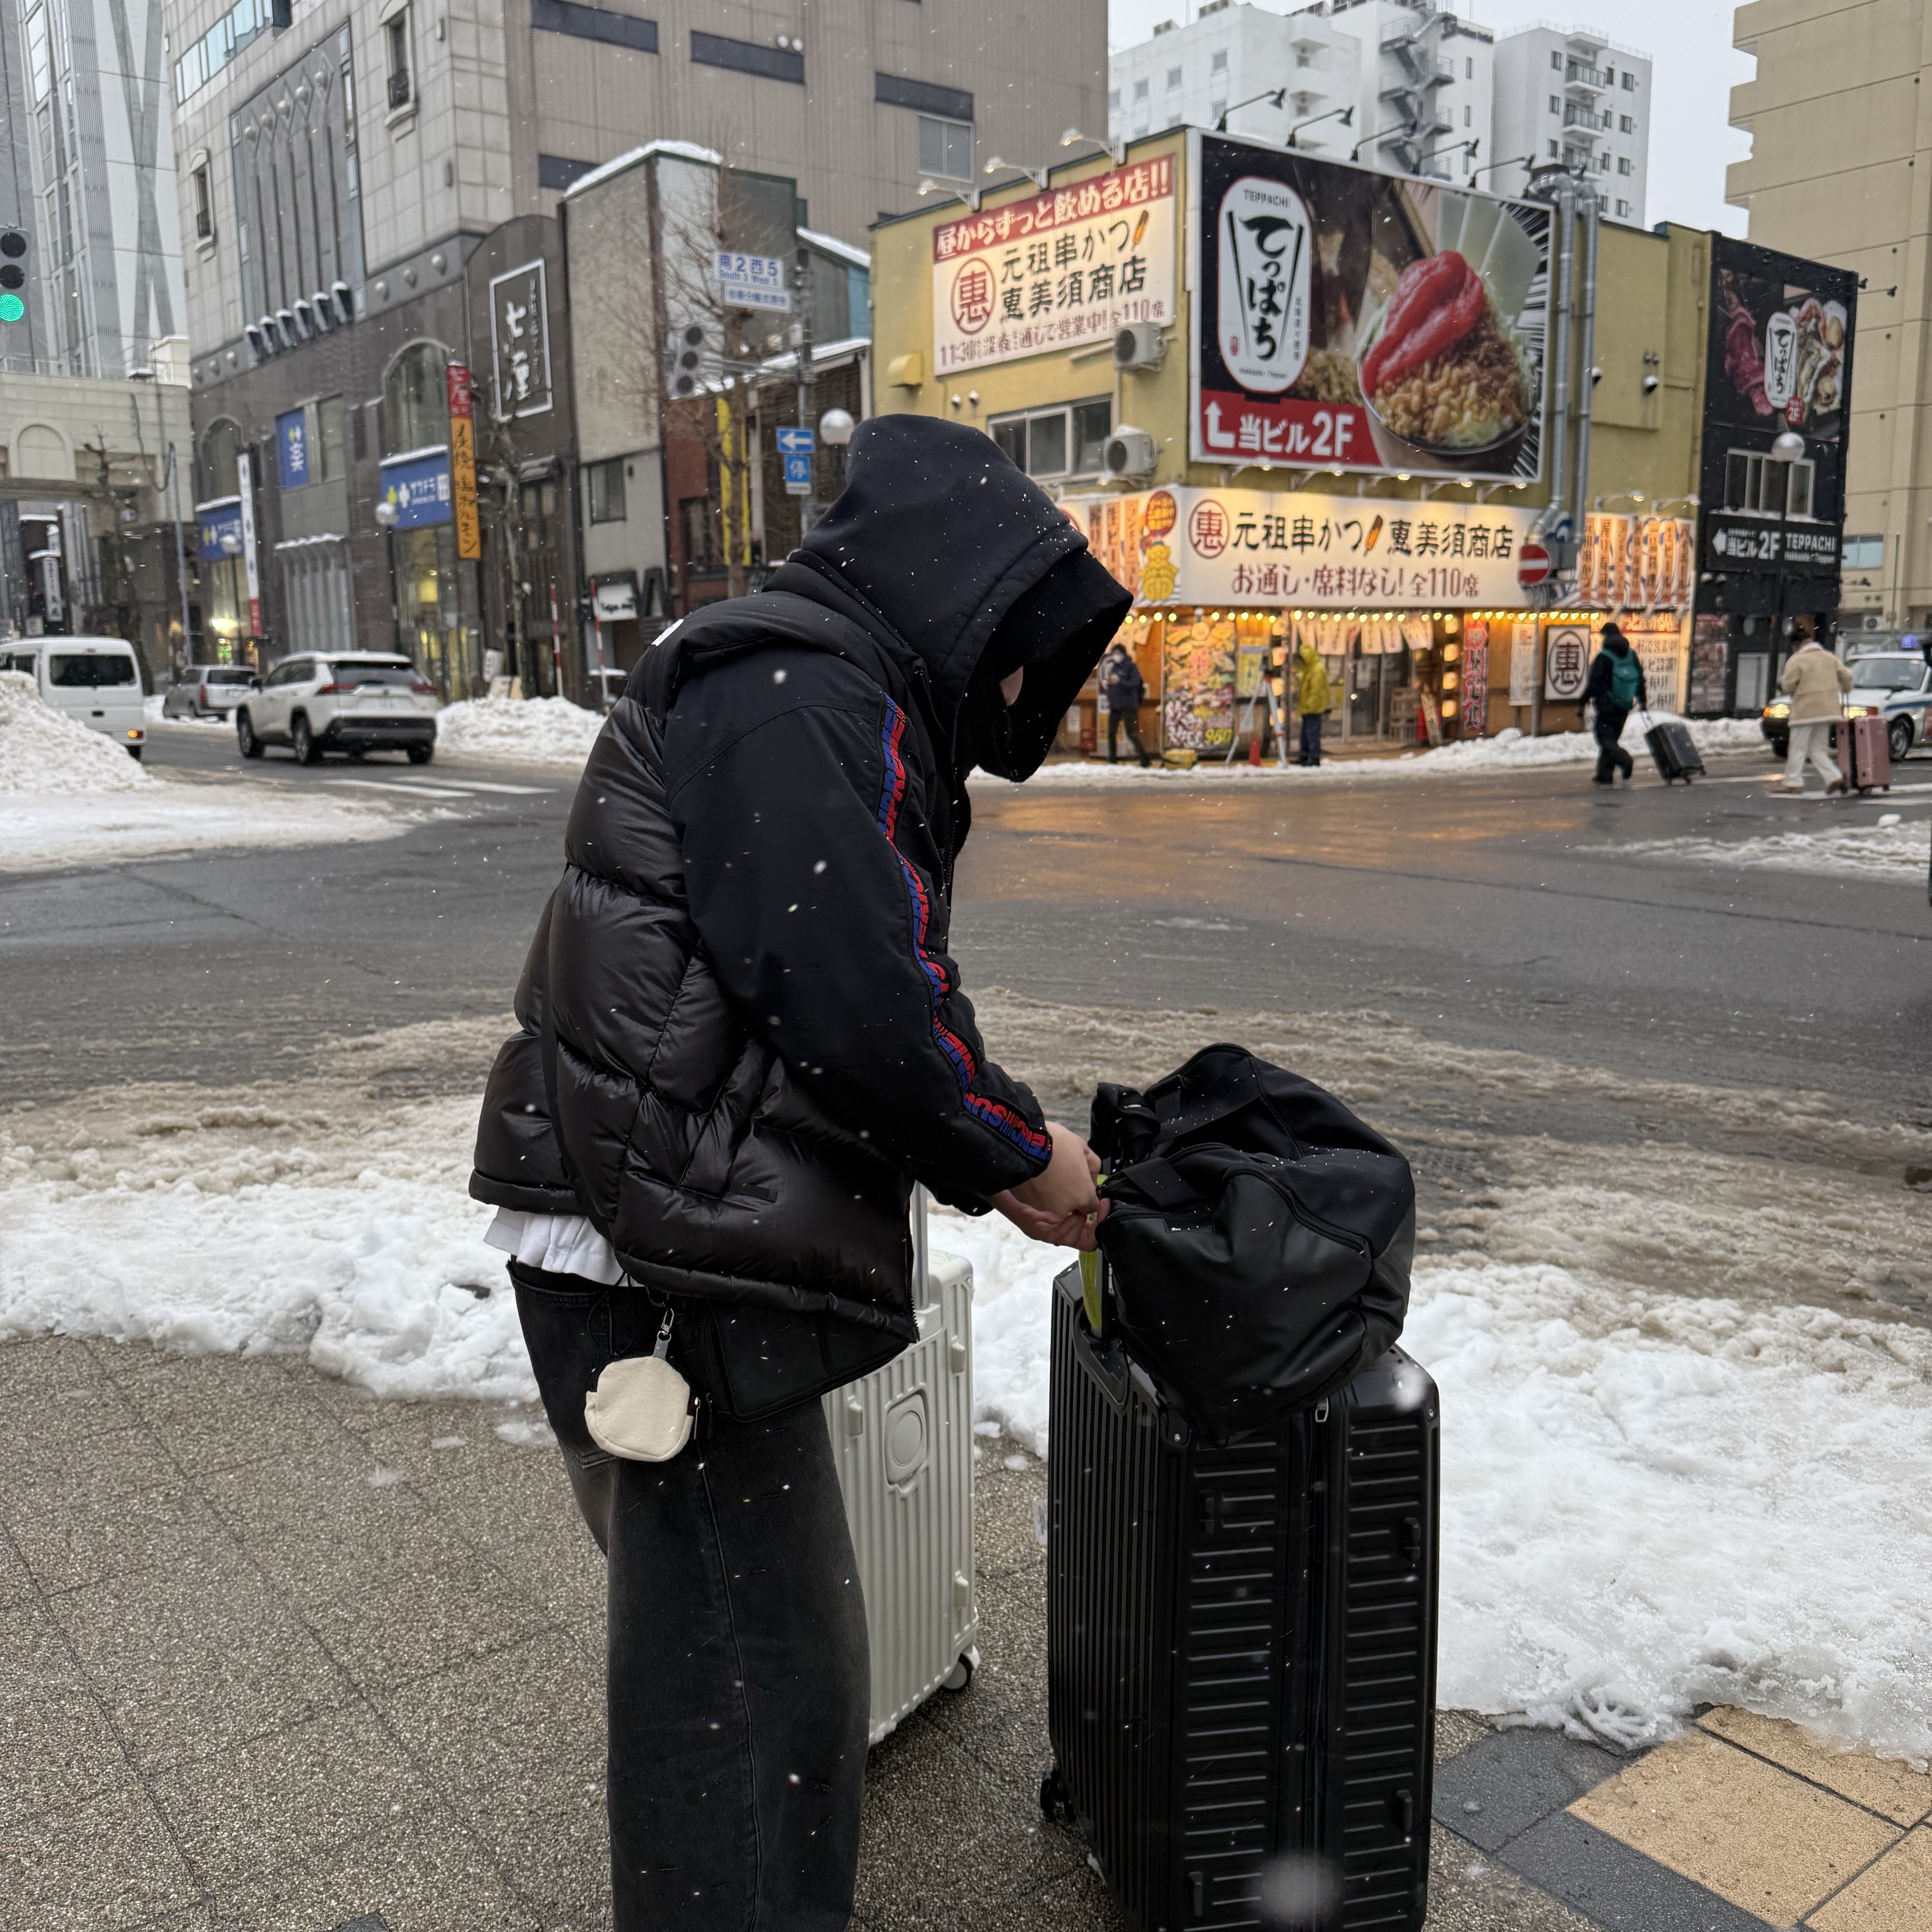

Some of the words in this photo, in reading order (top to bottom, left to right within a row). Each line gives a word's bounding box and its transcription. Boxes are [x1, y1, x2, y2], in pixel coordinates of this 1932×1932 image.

[1000, 220, 1129, 285] 元祖串かつ
[1238, 216, 1294, 361] てっぱち
[1773, 329, 1791, 395] てっぱち
[1238, 411, 1354, 456] 当ビル2F
[1232, 512, 1362, 555] 元祖串かつ
[1785, 532, 1835, 551] TEPPACHI
